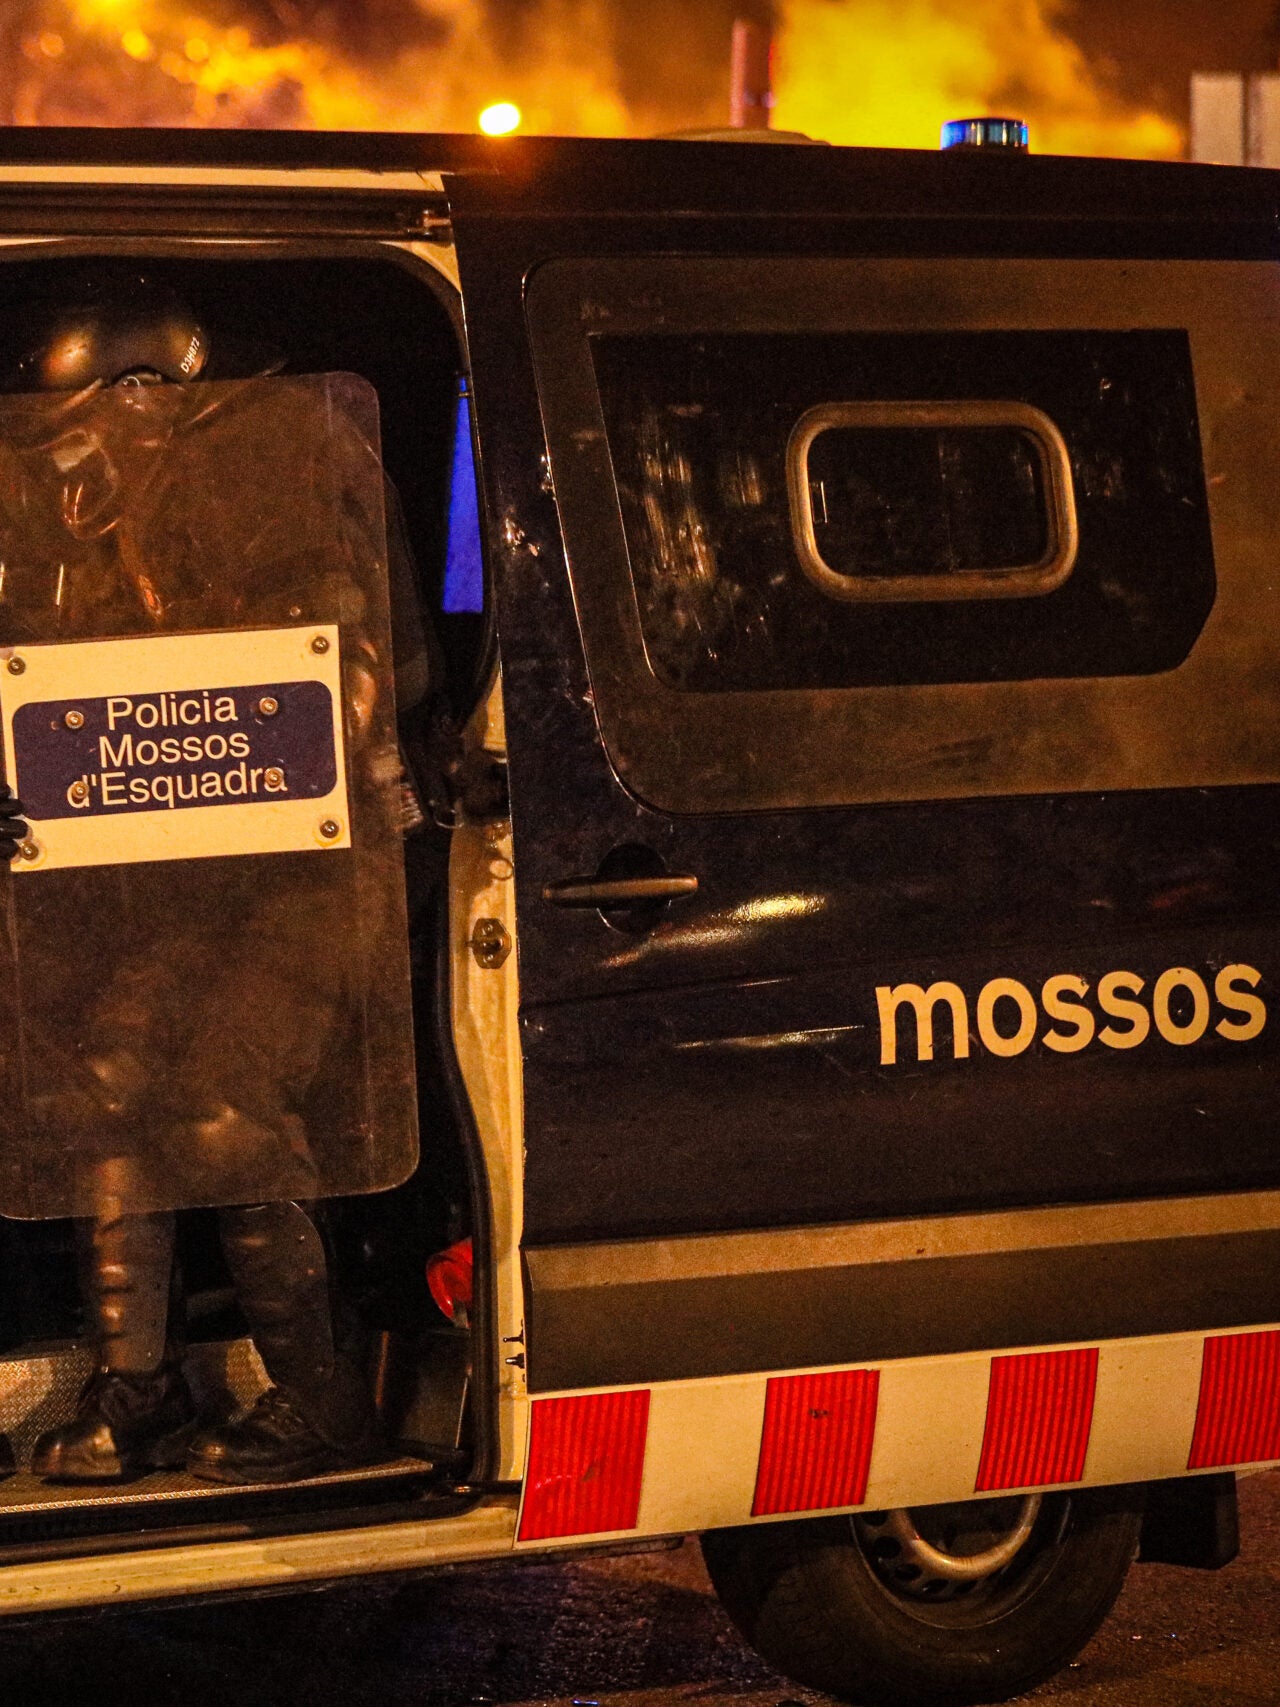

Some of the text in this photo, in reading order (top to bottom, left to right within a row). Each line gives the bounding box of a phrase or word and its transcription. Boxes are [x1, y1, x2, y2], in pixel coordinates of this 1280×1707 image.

[106, 691, 238, 731] Policia
[99, 732, 251, 768] Mossos
[875, 963, 1267, 1065] mossos
